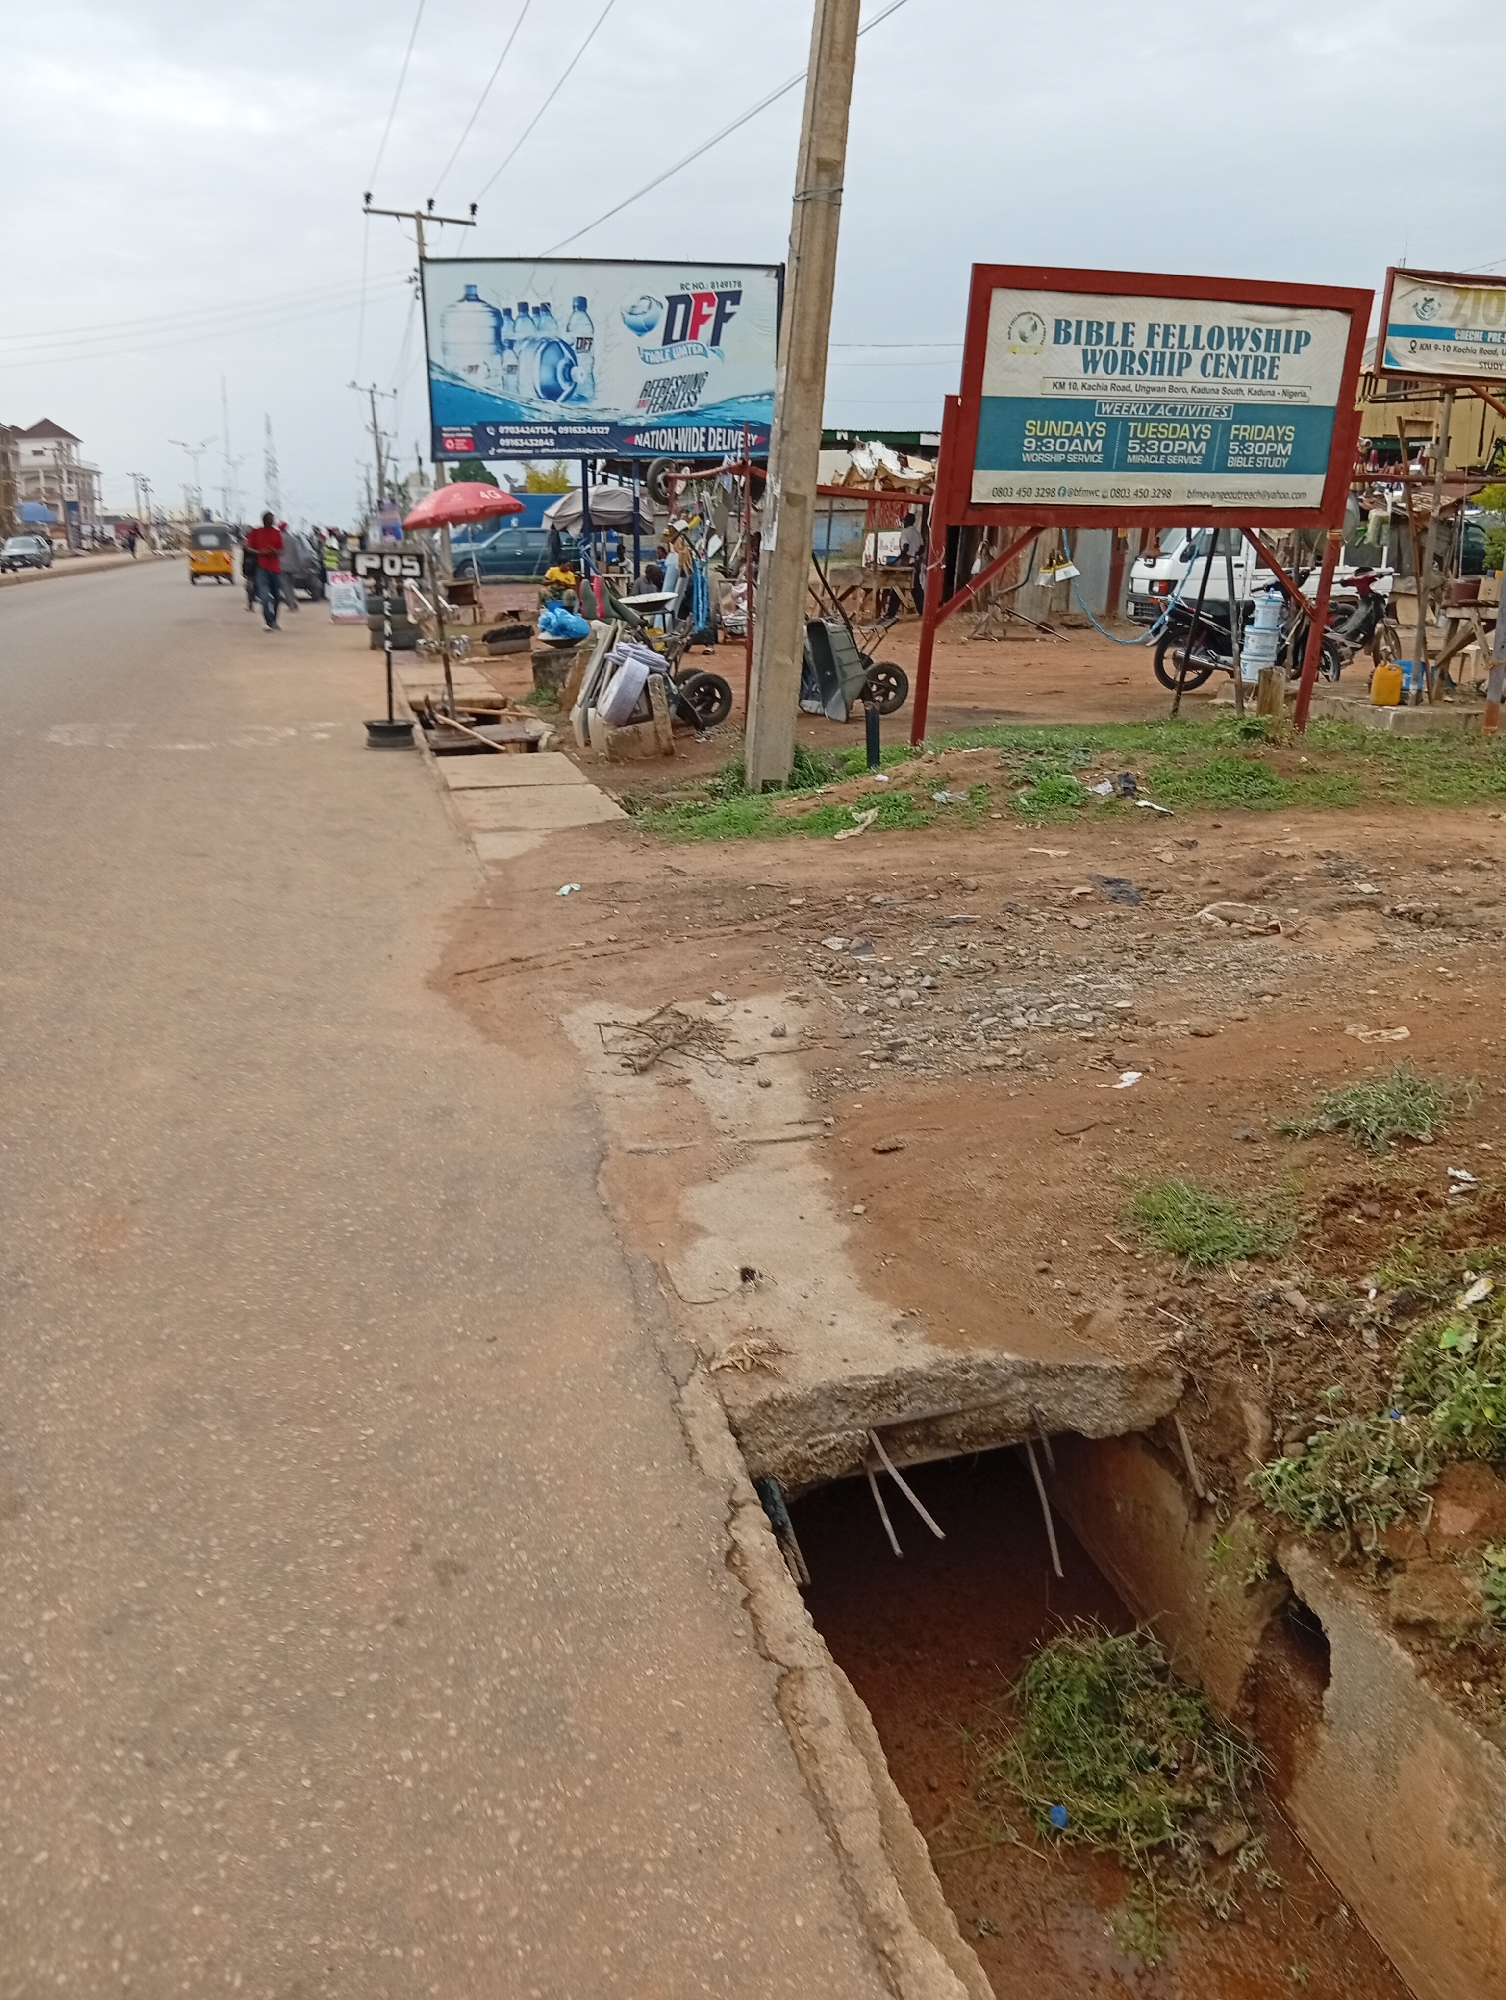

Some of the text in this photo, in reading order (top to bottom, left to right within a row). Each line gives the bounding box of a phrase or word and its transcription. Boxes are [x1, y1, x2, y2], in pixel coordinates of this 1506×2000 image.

[681, 283, 690, 291] RC
[710, 281, 742, 289] 8149178
[1448, 287, 1506, 326] ZIO
[662, 290, 742, 346] DFF
[1053, 318, 1135, 348] BIBLE
[1146, 322, 1311, 355] FELLOWSHIP
[1420, 343, 1432, 351] KM
[1434, 344, 1450, 352] 9-10
[1453, 345, 1477, 354] Kachia
[1479, 347, 1499, 356] Road,
[1082, 348, 1280, 380] WORSHIP CENTRE
[1479, 361, 1504, 371] STUDY
[1052, 381, 1066, 391] KM
[1068, 382, 1079, 392] 10,
[1081, 382, 1108, 392] Kachia
[1110, 383, 1133, 394] Road,
[1135, 384, 1166, 395] Ungwan
[1168, 385, 1189, 395] Boro,
[1191, 386, 1219, 396] Kaduna
[1221, 387, 1245, 397] South,
[1247, 388, 1275, 397] Kaduna
[1101, 402, 1229, 418] WEEKLY ACTIVITIES
[1025, 420, 1107, 437] SUNDAYS
[1128, 422, 1212, 440] TUESDAYS
[1230, 425, 1295, 442] FRIDAYS
[634, 427, 705, 452] NATION-WIDE
[1022, 438, 1103, 453] 9:30AM
[1127, 440, 1206, 455] 5:30PM
[1229, 442, 1293, 456] 5:30PM
[1022, 453, 1104, 464] WORSHIP SERVICE
[1127, 454, 1203, 465] MIRACLE SERVICE
[1227, 456, 1289, 468] BIBLE STUDY
[480, 489, 502, 500] 4G
[992, 487, 1013, 497] 0803
[1016, 487, 1032, 497] 450
[1034, 487, 1056, 498] 3298
[1067, 486, 1100, 497] @bfmwc
[1110, 488, 1131, 498] 0803
[1133, 488, 1149, 499] 450
[1151, 488, 1172, 499] 3298
[355, 554, 421, 576] POS
